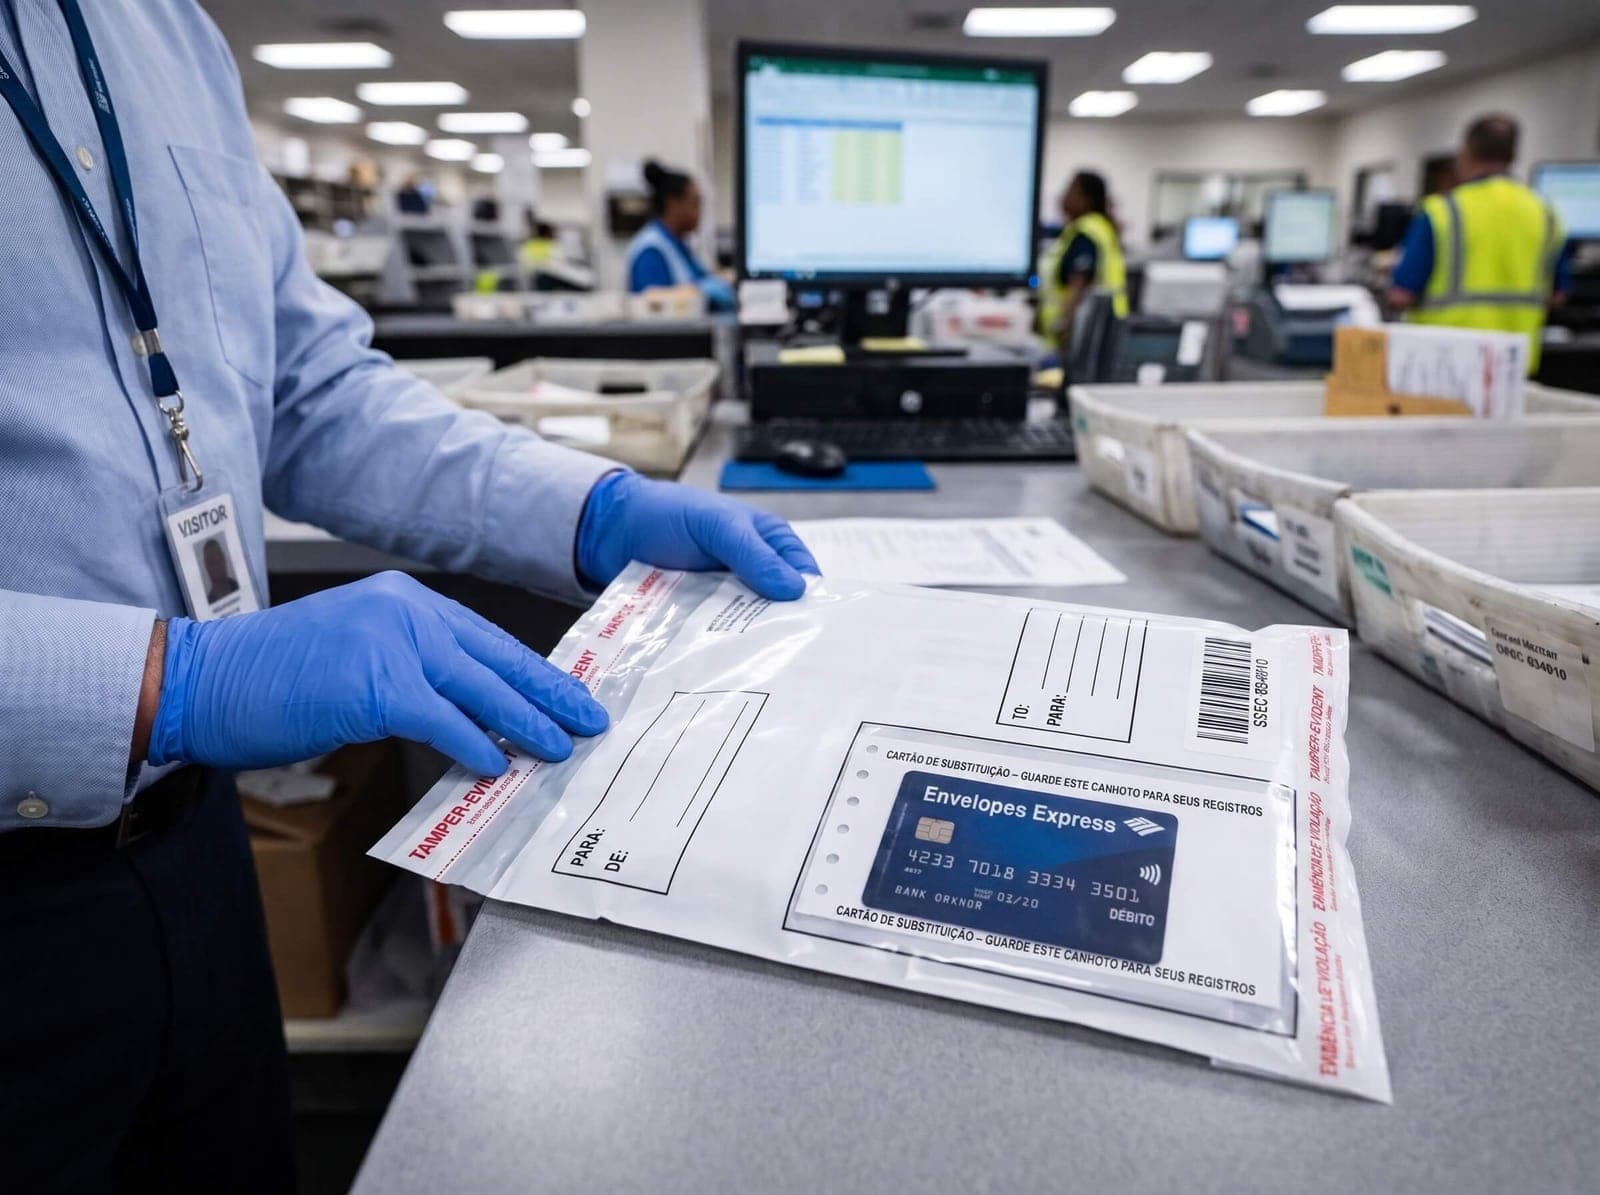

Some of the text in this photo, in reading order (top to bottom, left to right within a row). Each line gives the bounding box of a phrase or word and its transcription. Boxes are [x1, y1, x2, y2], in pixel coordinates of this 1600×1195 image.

[177, 504, 228, 538] VISITOR
[1011, 704, 1030, 720] TO:
[1046, 694, 1067, 727] PARA:
[886, 749, 924, 764] CARTÃO
[925, 757, 940, 767] DE
[940, 758, 1011, 778] SUBSTITUIÇÃO
[1020, 771, 1062, 786] GUARDE
[1063, 777, 1089, 790] ESTE
[1091, 782, 1141, 798] CANHOTO
[1142, 789, 1171, 803] PARA
[1172, 794, 1200, 807] SEUS
[1203, 799, 1264, 817] REGISTROS
[923, 785, 1117, 834] Envelopes Express
[569, 828, 606, 867] PARA:
[604, 850, 629, 873] DE:
[908, 849, 1140, 903] 4233 7018 3334 3501
[1109, 907, 1155, 927] DÉBITO
[879, 914, 896, 926] DE
[985, 935, 1031, 953] GUARDE
[1033, 943, 1061, 959] ESTE
[1063, 949, 1119, 970] CANHOTO
[1121, 960, 1151, 977] PARA
[1154, 966, 1185, 982] SEUS
[1188, 973, 1256, 996] REGISTROS
